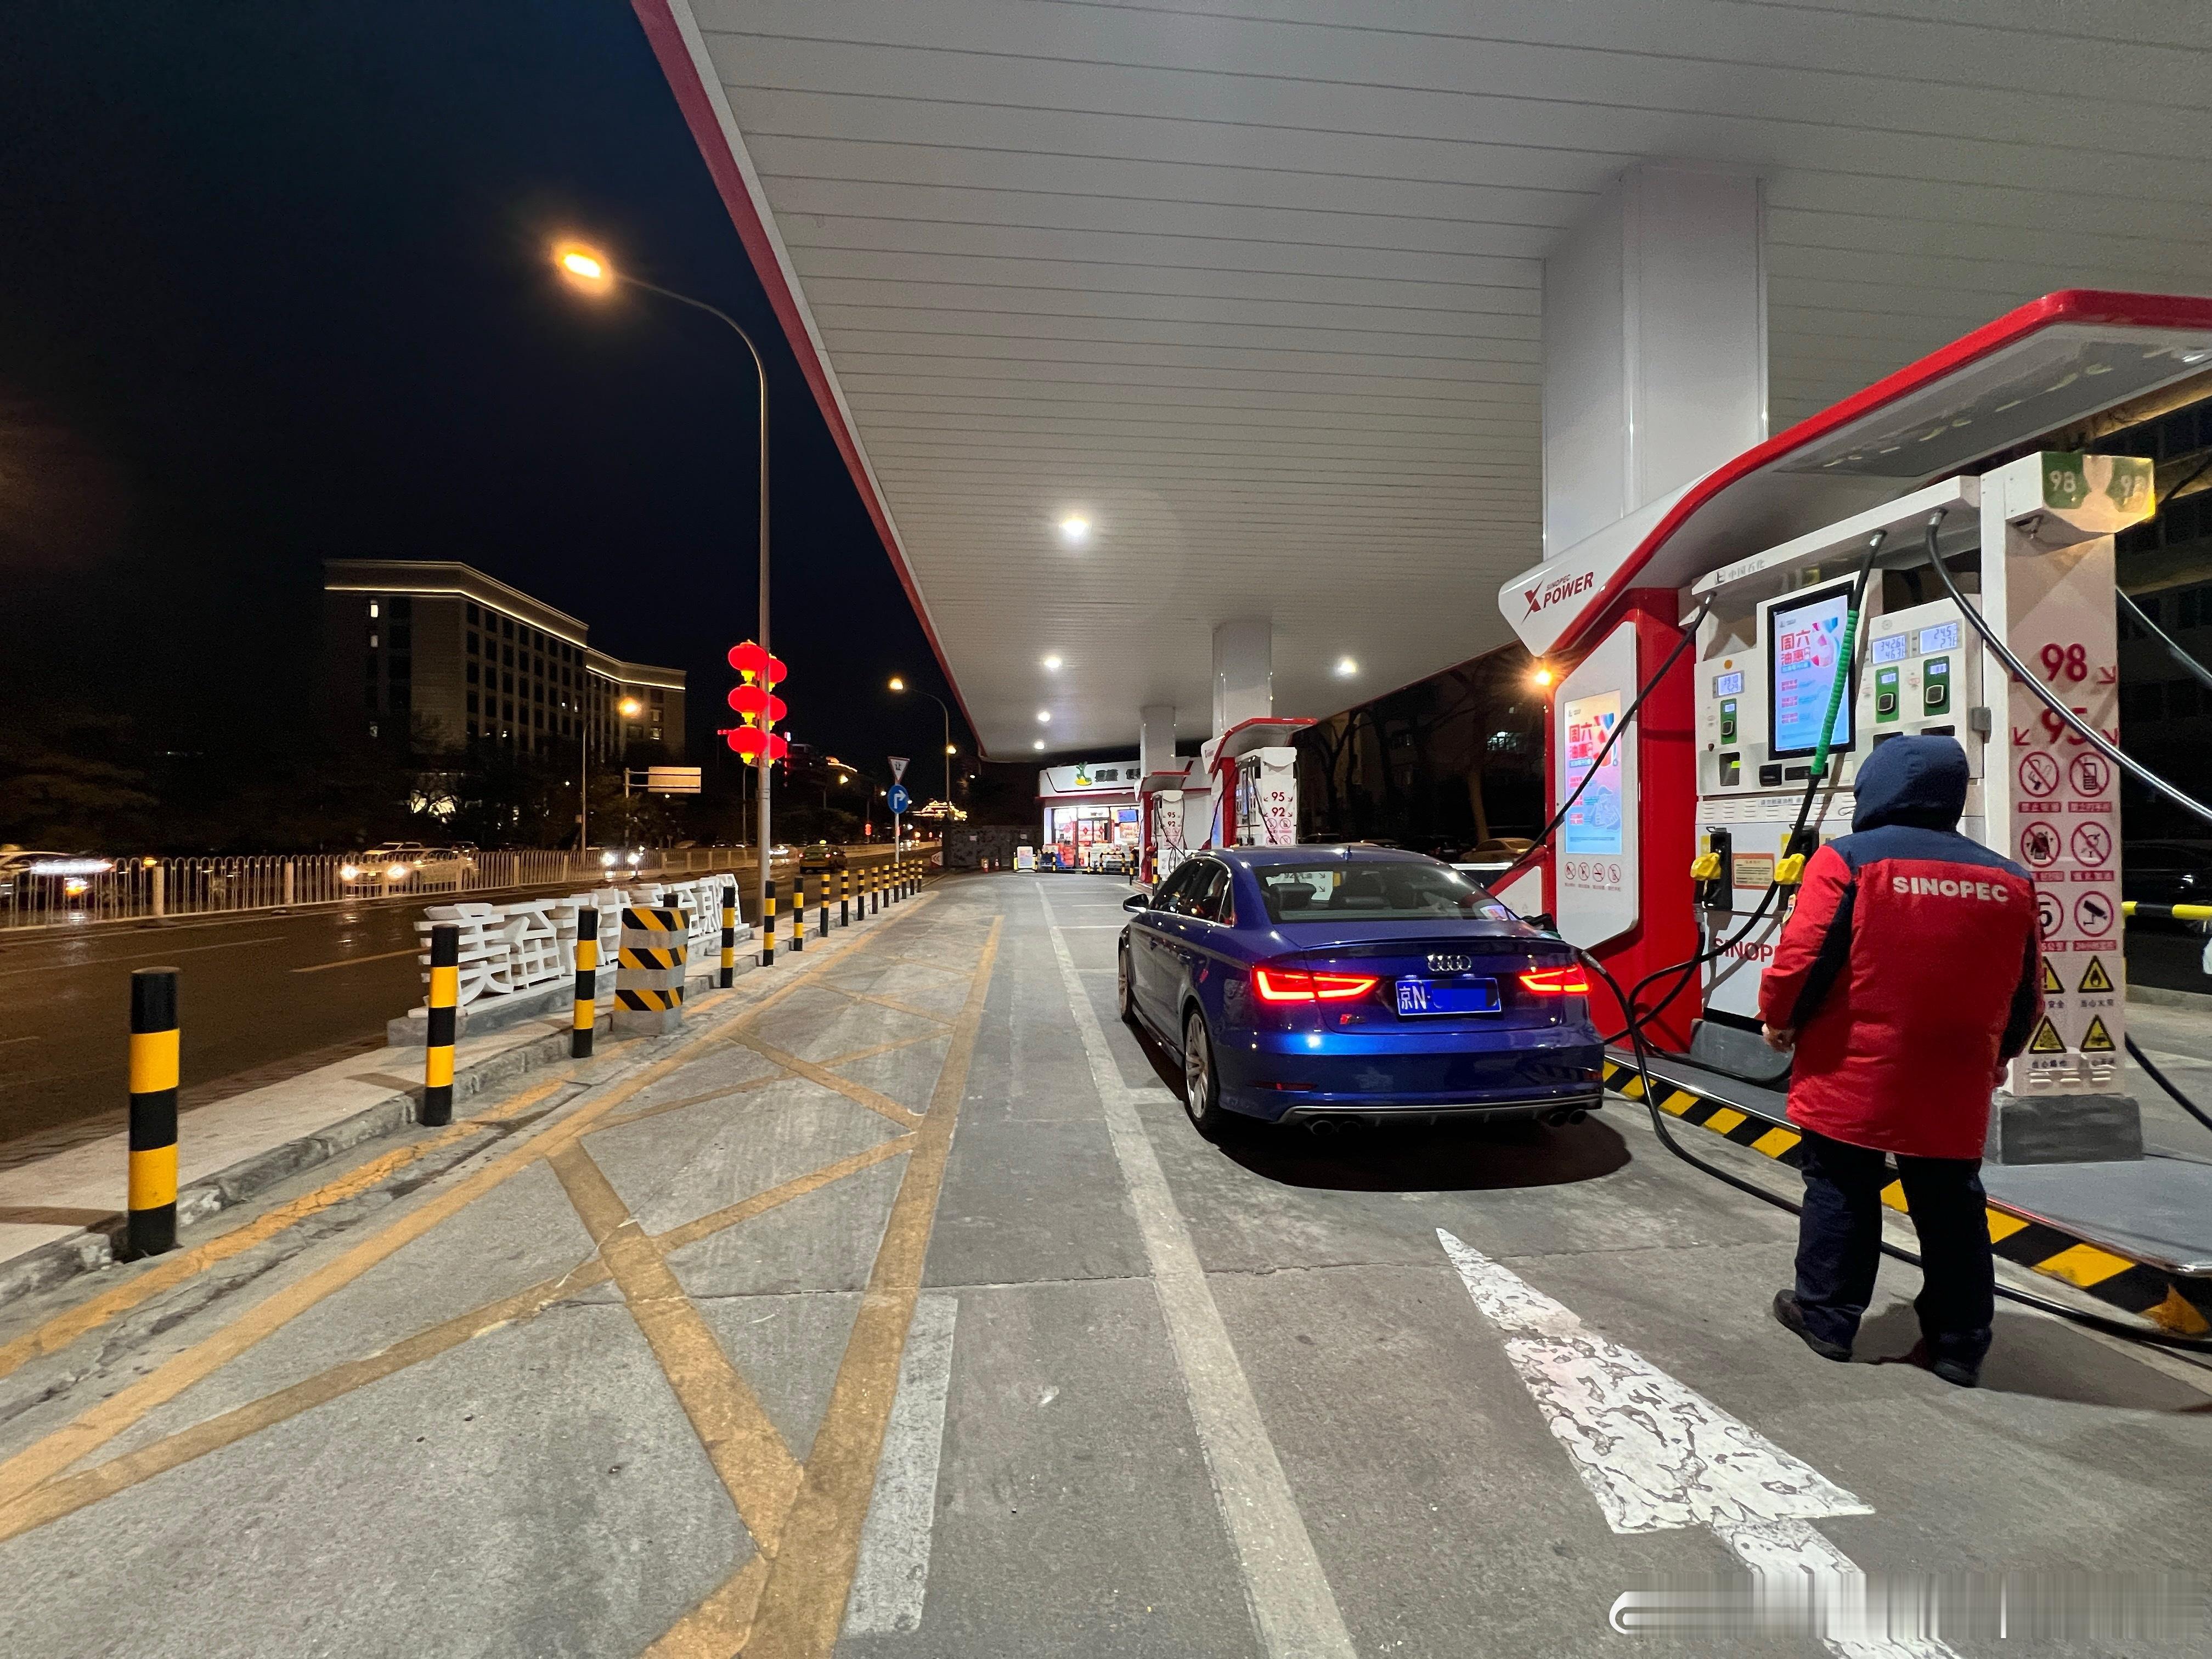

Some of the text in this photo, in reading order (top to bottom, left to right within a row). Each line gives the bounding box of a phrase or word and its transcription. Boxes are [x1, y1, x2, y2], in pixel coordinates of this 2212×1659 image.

[2050, 470, 2076, 493] 98
[1729, 558, 1765, 579] 中国石化
[1543, 572, 1593, 608] POWER
[1781, 630, 1810, 651] 周六
[2042, 643, 2087, 681] 98
[1569, 722, 1592, 743] 周六
[1272, 792, 1285, 802] 95
[1272, 807, 1285, 817] 92
[1893, 877, 2008, 902] SINOPEC
[1714, 938, 1773, 962] SINOP
